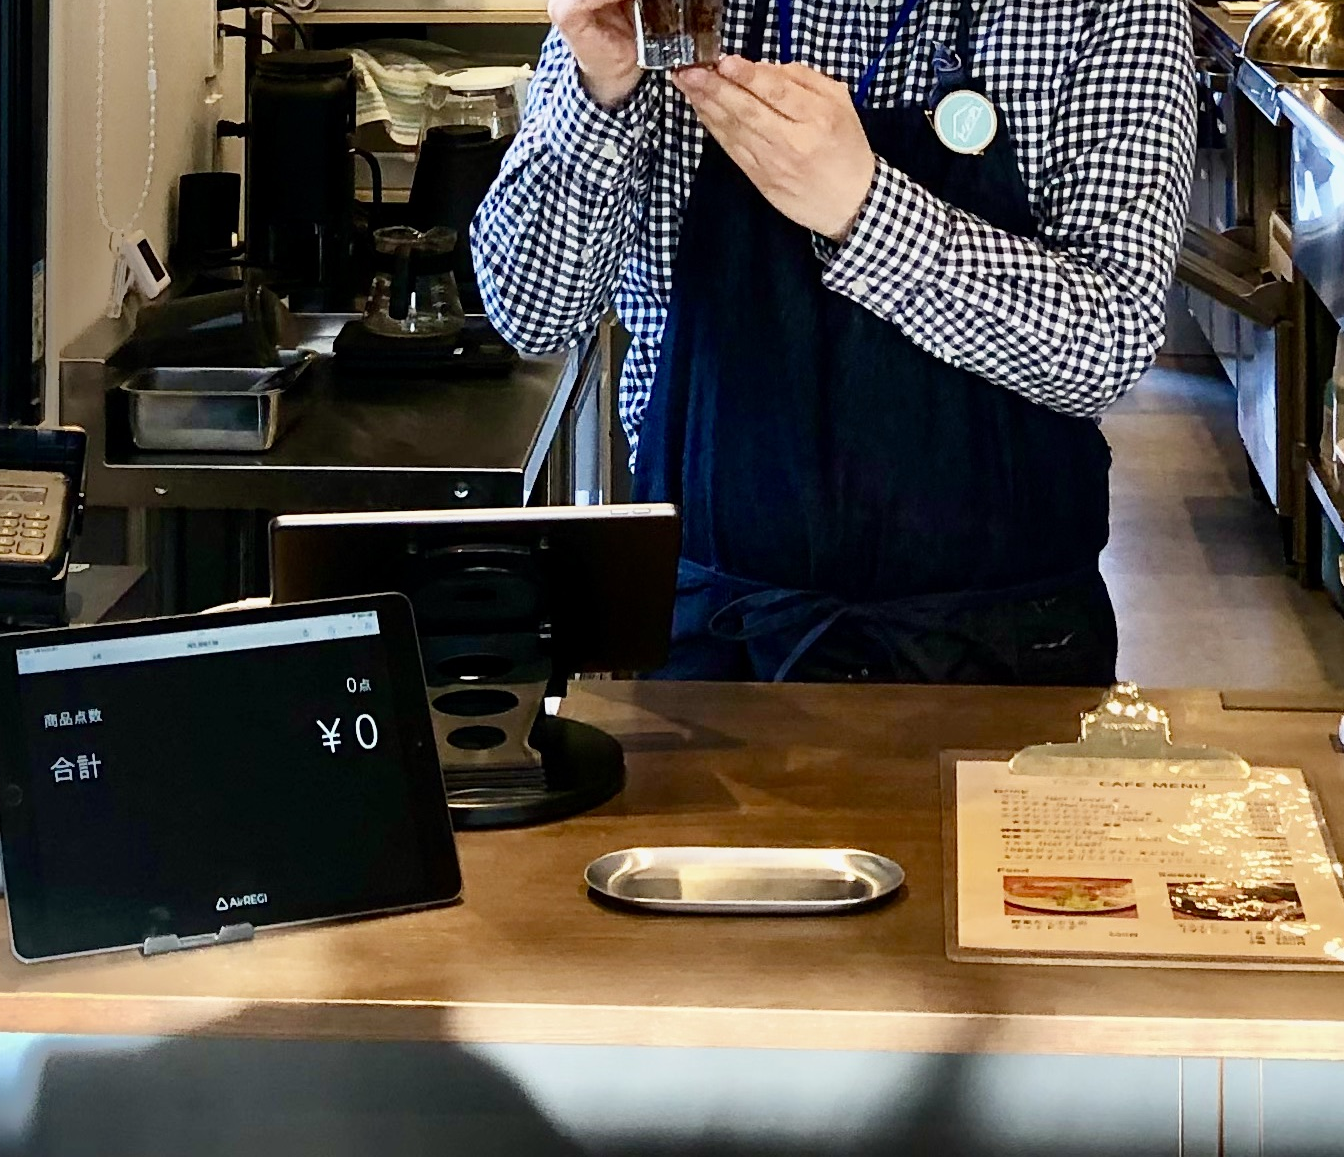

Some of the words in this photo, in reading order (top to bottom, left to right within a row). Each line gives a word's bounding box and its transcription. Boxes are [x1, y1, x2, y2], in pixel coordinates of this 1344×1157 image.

[44, 707, 103, 729] 商品点数
[50, 752, 102, 783] 合計
[1098, 780, 1146, 789] CAFE
[1152, 781, 1207, 790] MENU
